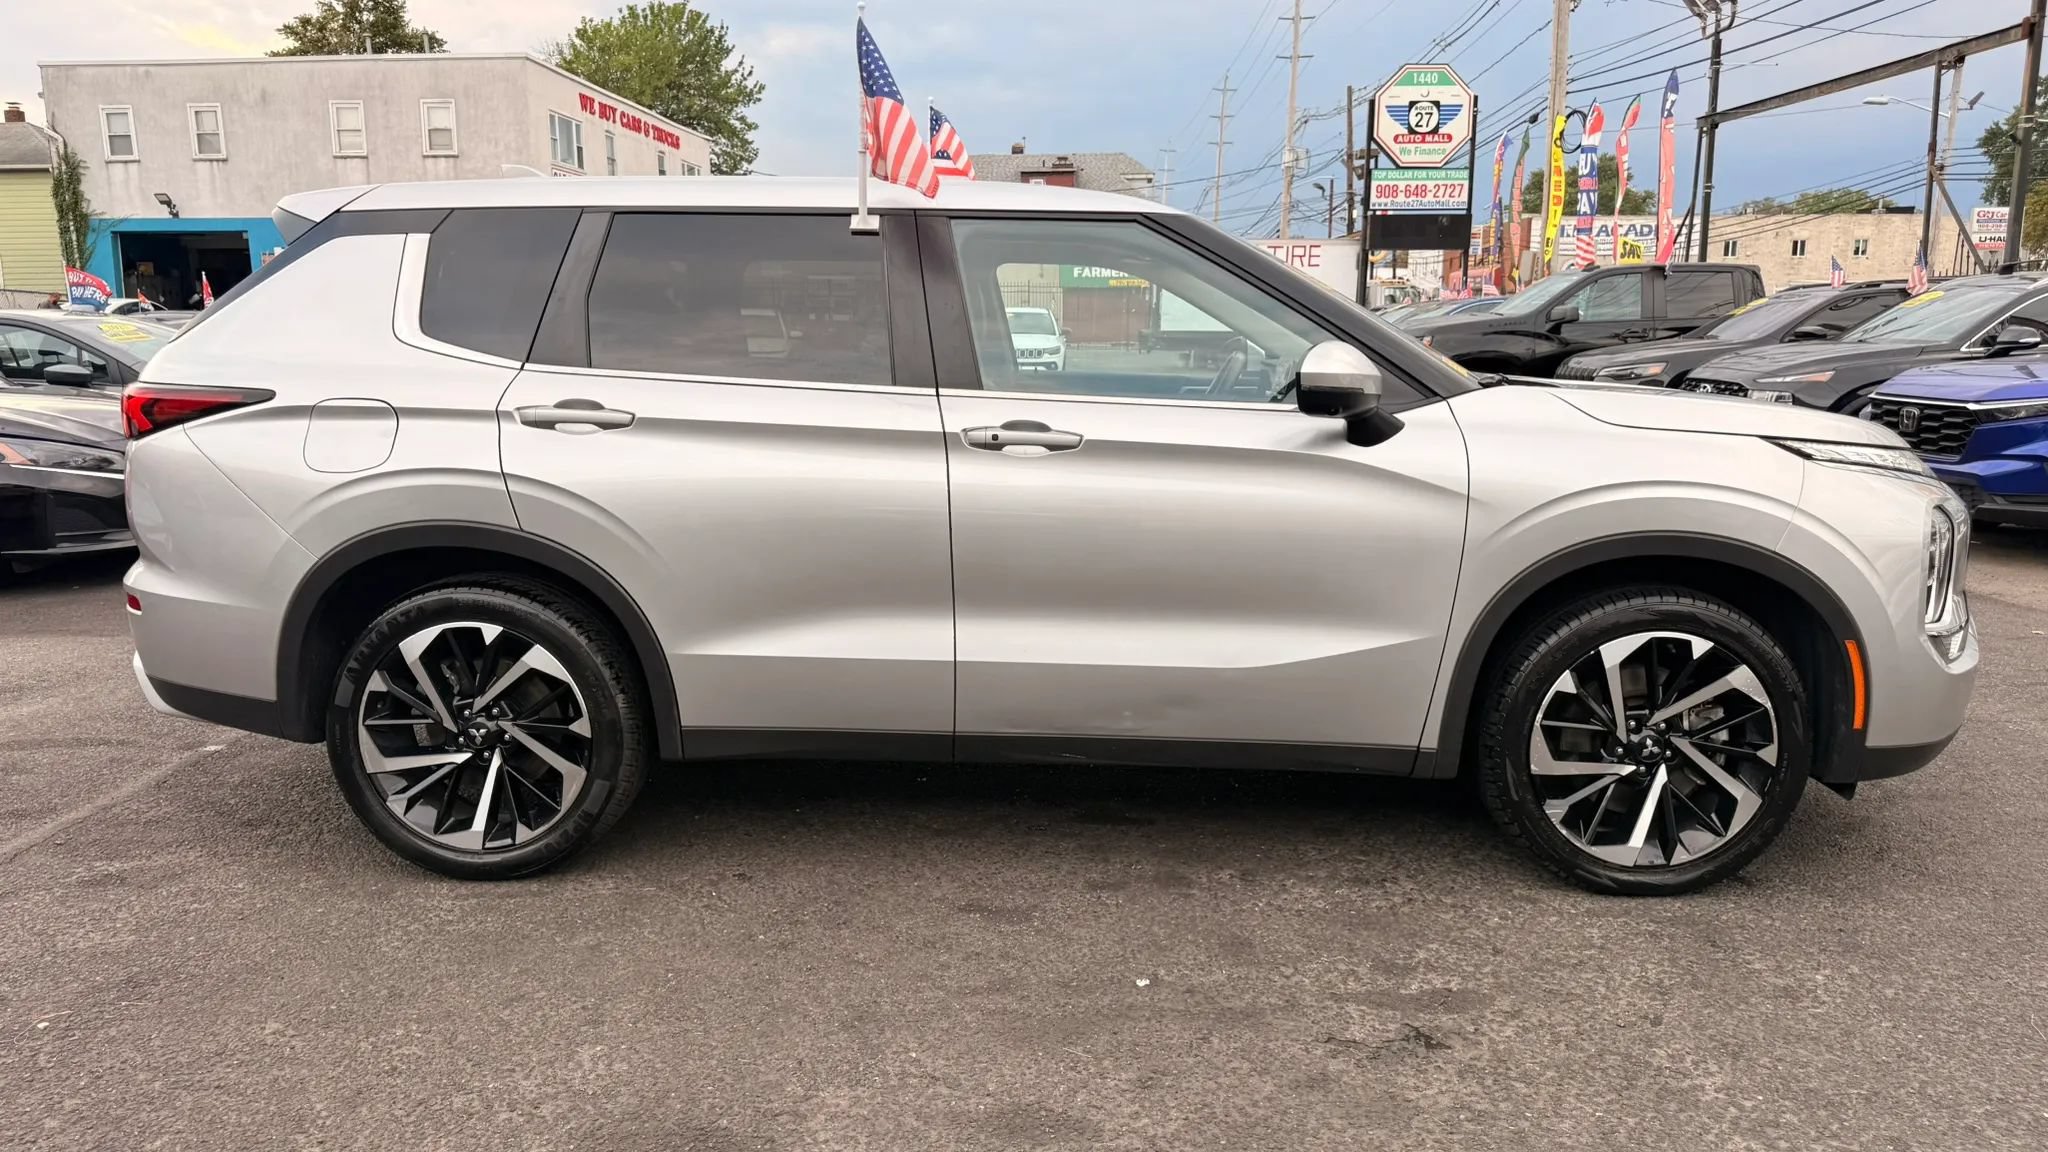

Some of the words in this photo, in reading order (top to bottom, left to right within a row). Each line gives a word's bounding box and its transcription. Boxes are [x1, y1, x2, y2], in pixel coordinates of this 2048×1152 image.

[1413, 72, 1438, 84] 1440
[578, 92, 596, 116] WE
[598, 101, 618, 124] BUY
[620, 110, 642, 134] CARS
[643, 121, 650, 138] &
[651, 123, 681, 150] TRUCKS
[1414, 112, 1434, 128] 27
[1397, 135, 1423, 143] AUTO
[1425, 134, 1450, 142] MALL
[1399, 146, 1412, 156] We
[1414, 146, 1447, 156] Finance
[1374, 171, 1386, 179] TOP
[1387, 171, 1413, 179] DOLLAR
[1413, 171, 1427, 179] FOR
[1428, 171, 1446, 179] YOUR
[1447, 170, 1468, 179] TRADE
[1375, 183, 1464, 199] 908-648-2727
[1267, 244, 1321, 267] TIRE
